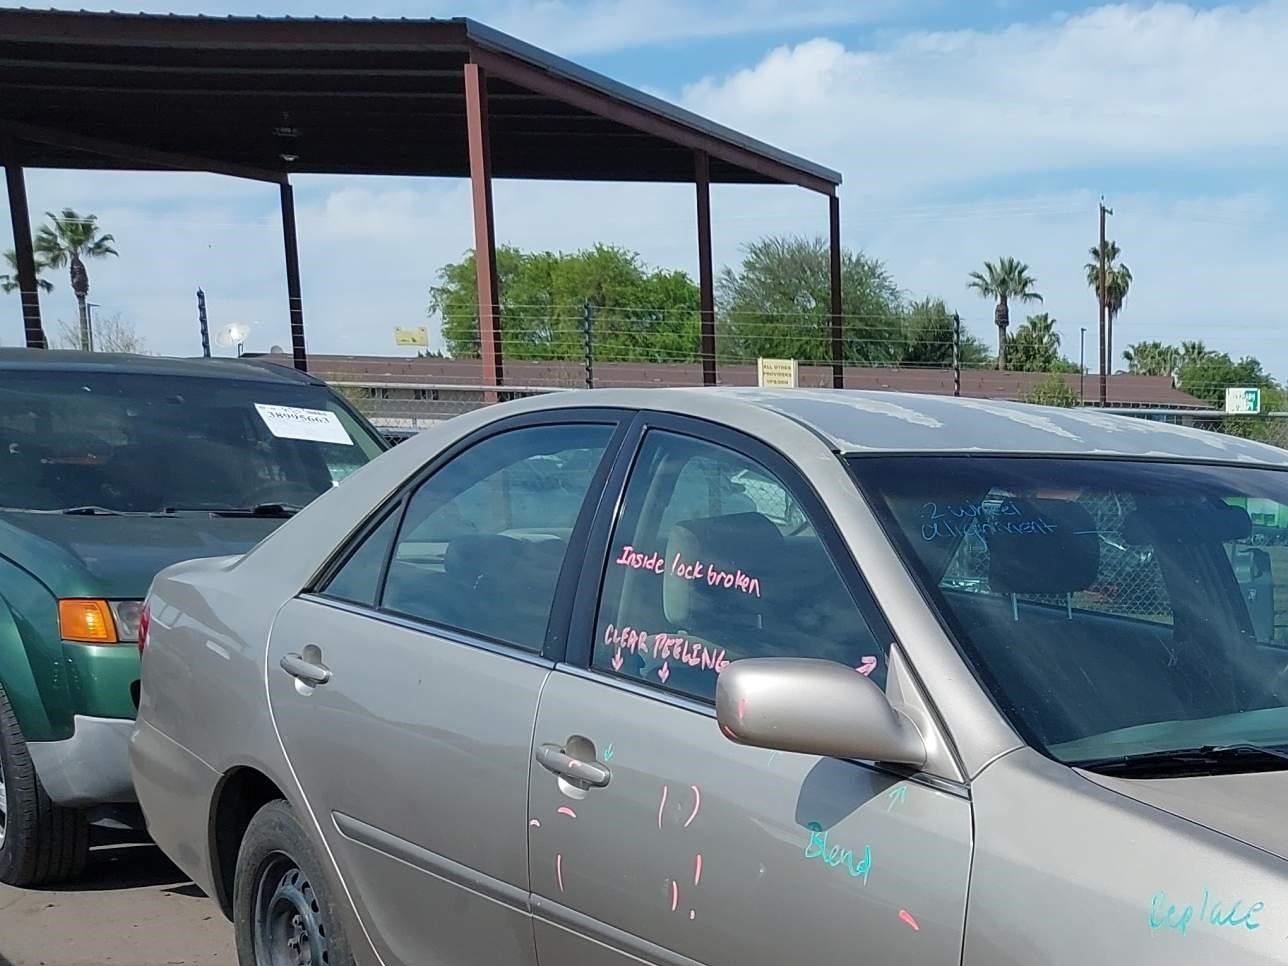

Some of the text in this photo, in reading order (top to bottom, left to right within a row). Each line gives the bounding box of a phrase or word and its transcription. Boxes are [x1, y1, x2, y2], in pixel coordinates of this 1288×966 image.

[616, 546, 761, 598] Inside lock broken
[604, 623, 649, 655] CLEAR
[805, 821, 872, 887] Blend
